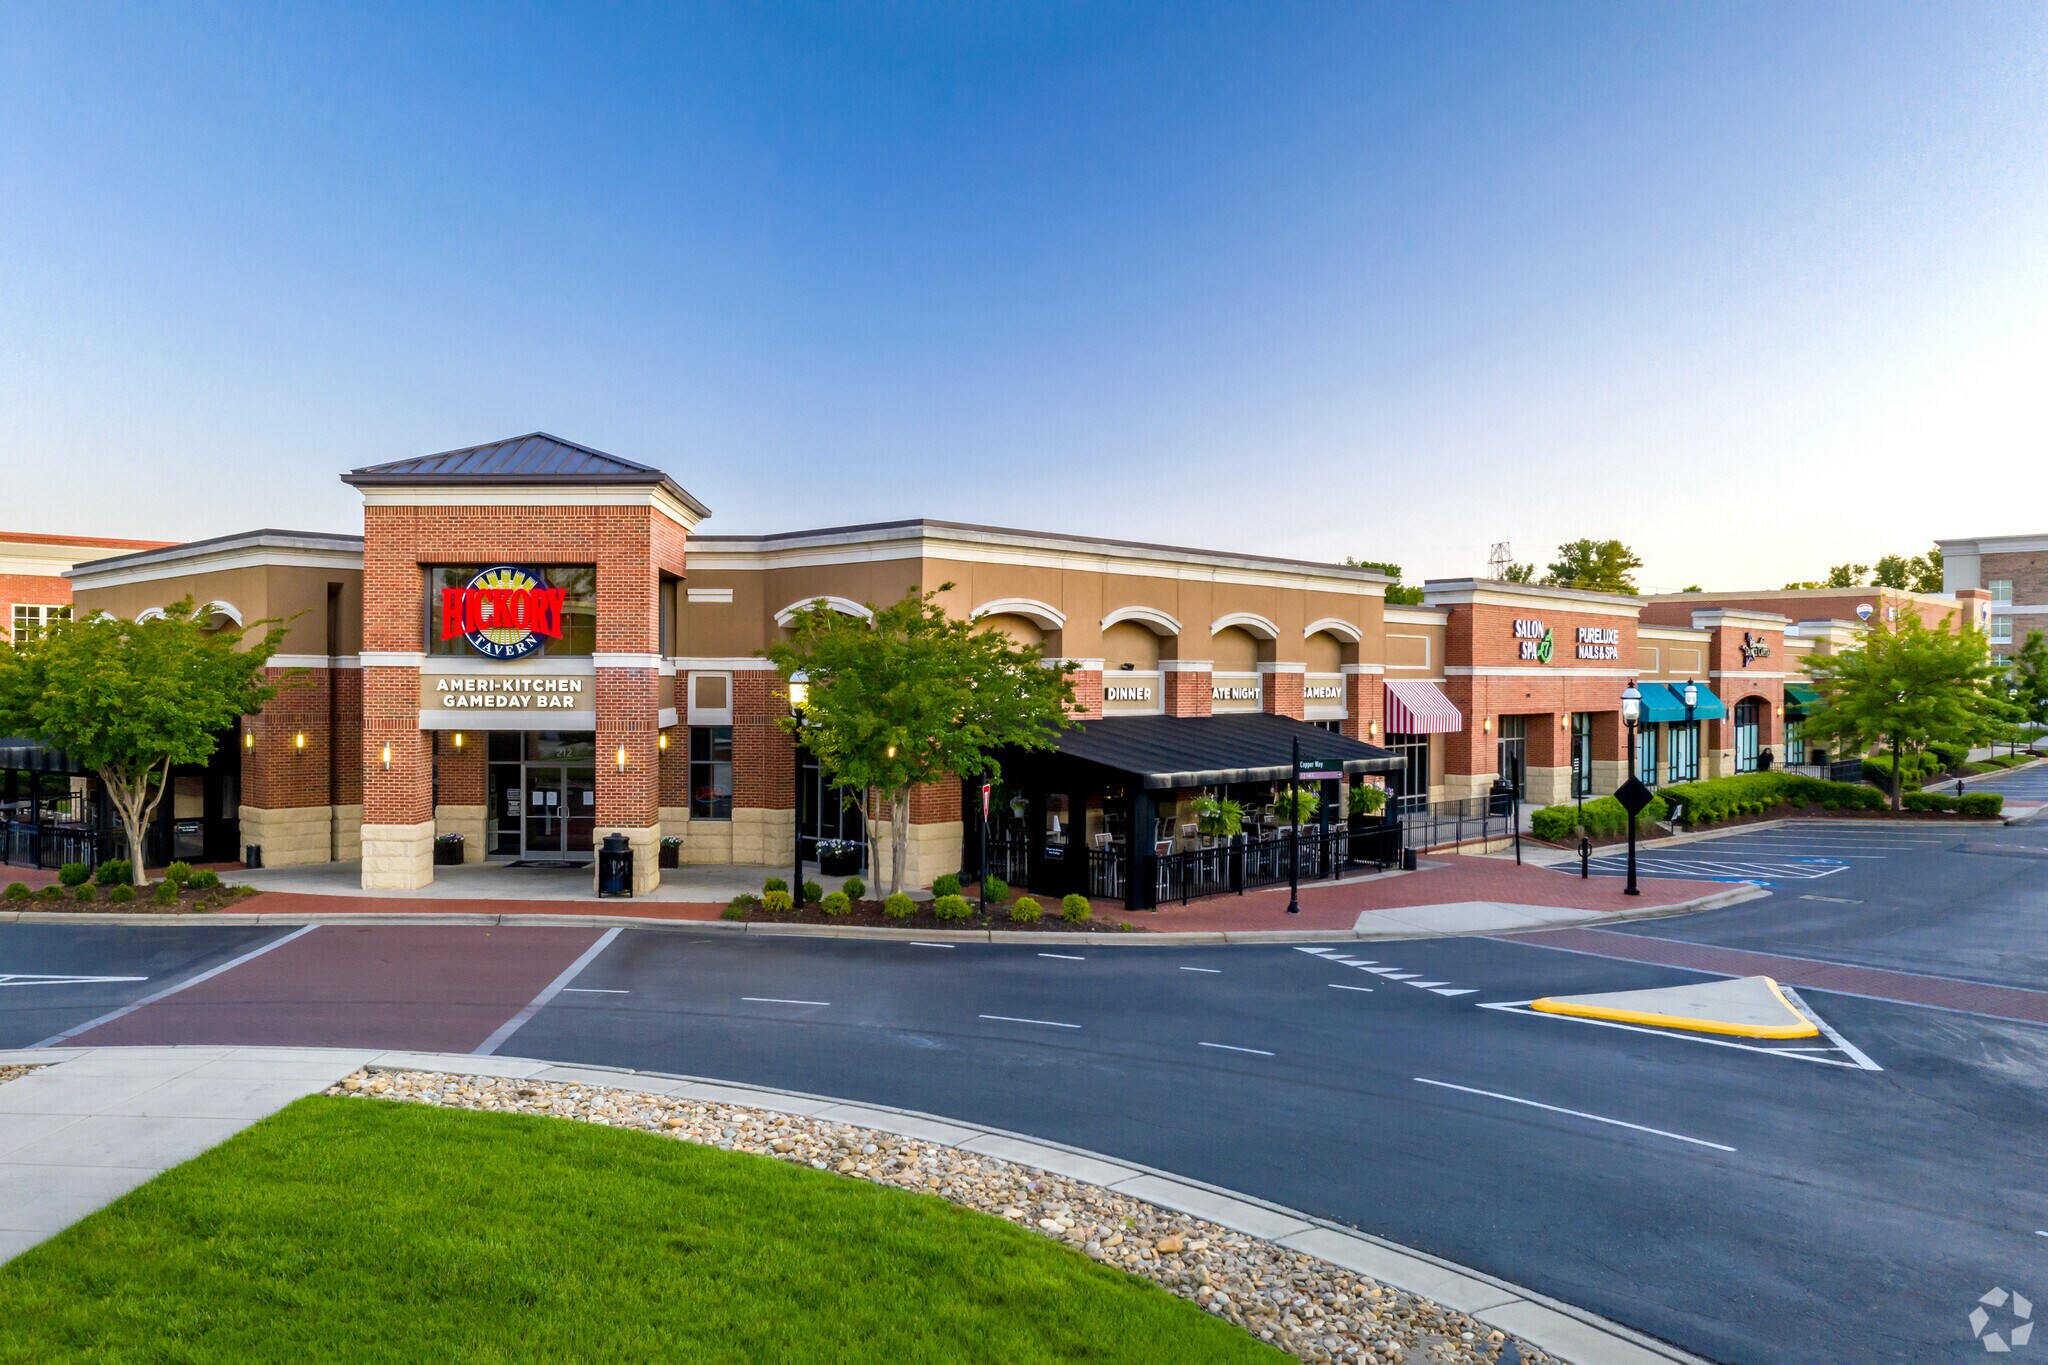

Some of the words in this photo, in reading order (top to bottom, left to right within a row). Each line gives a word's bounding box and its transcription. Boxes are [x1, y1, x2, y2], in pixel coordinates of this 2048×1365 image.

[440, 588, 567, 641] HICKORY
[1514, 619, 1545, 638] SALON
[1578, 627, 1619, 644] PURELUXE
[474, 634, 538, 656] TAVERN
[1521, 641, 1538, 659] SPA
[1578, 645, 1600, 658] NAILS
[1599, 646, 1604, 658] &
[1605, 646, 1618, 660] SPA
[436, 678, 583, 692] AMERI-KITCHEN
[1107, 687, 1152, 700] DINNER
[1212, 687, 1231, 699] ATE
[1232, 687, 1260, 699] NIGHT
[443, 695, 532, 708] GAMEDAY
[537, 695, 575, 708] BAR
[556, 748, 573, 757] 212
